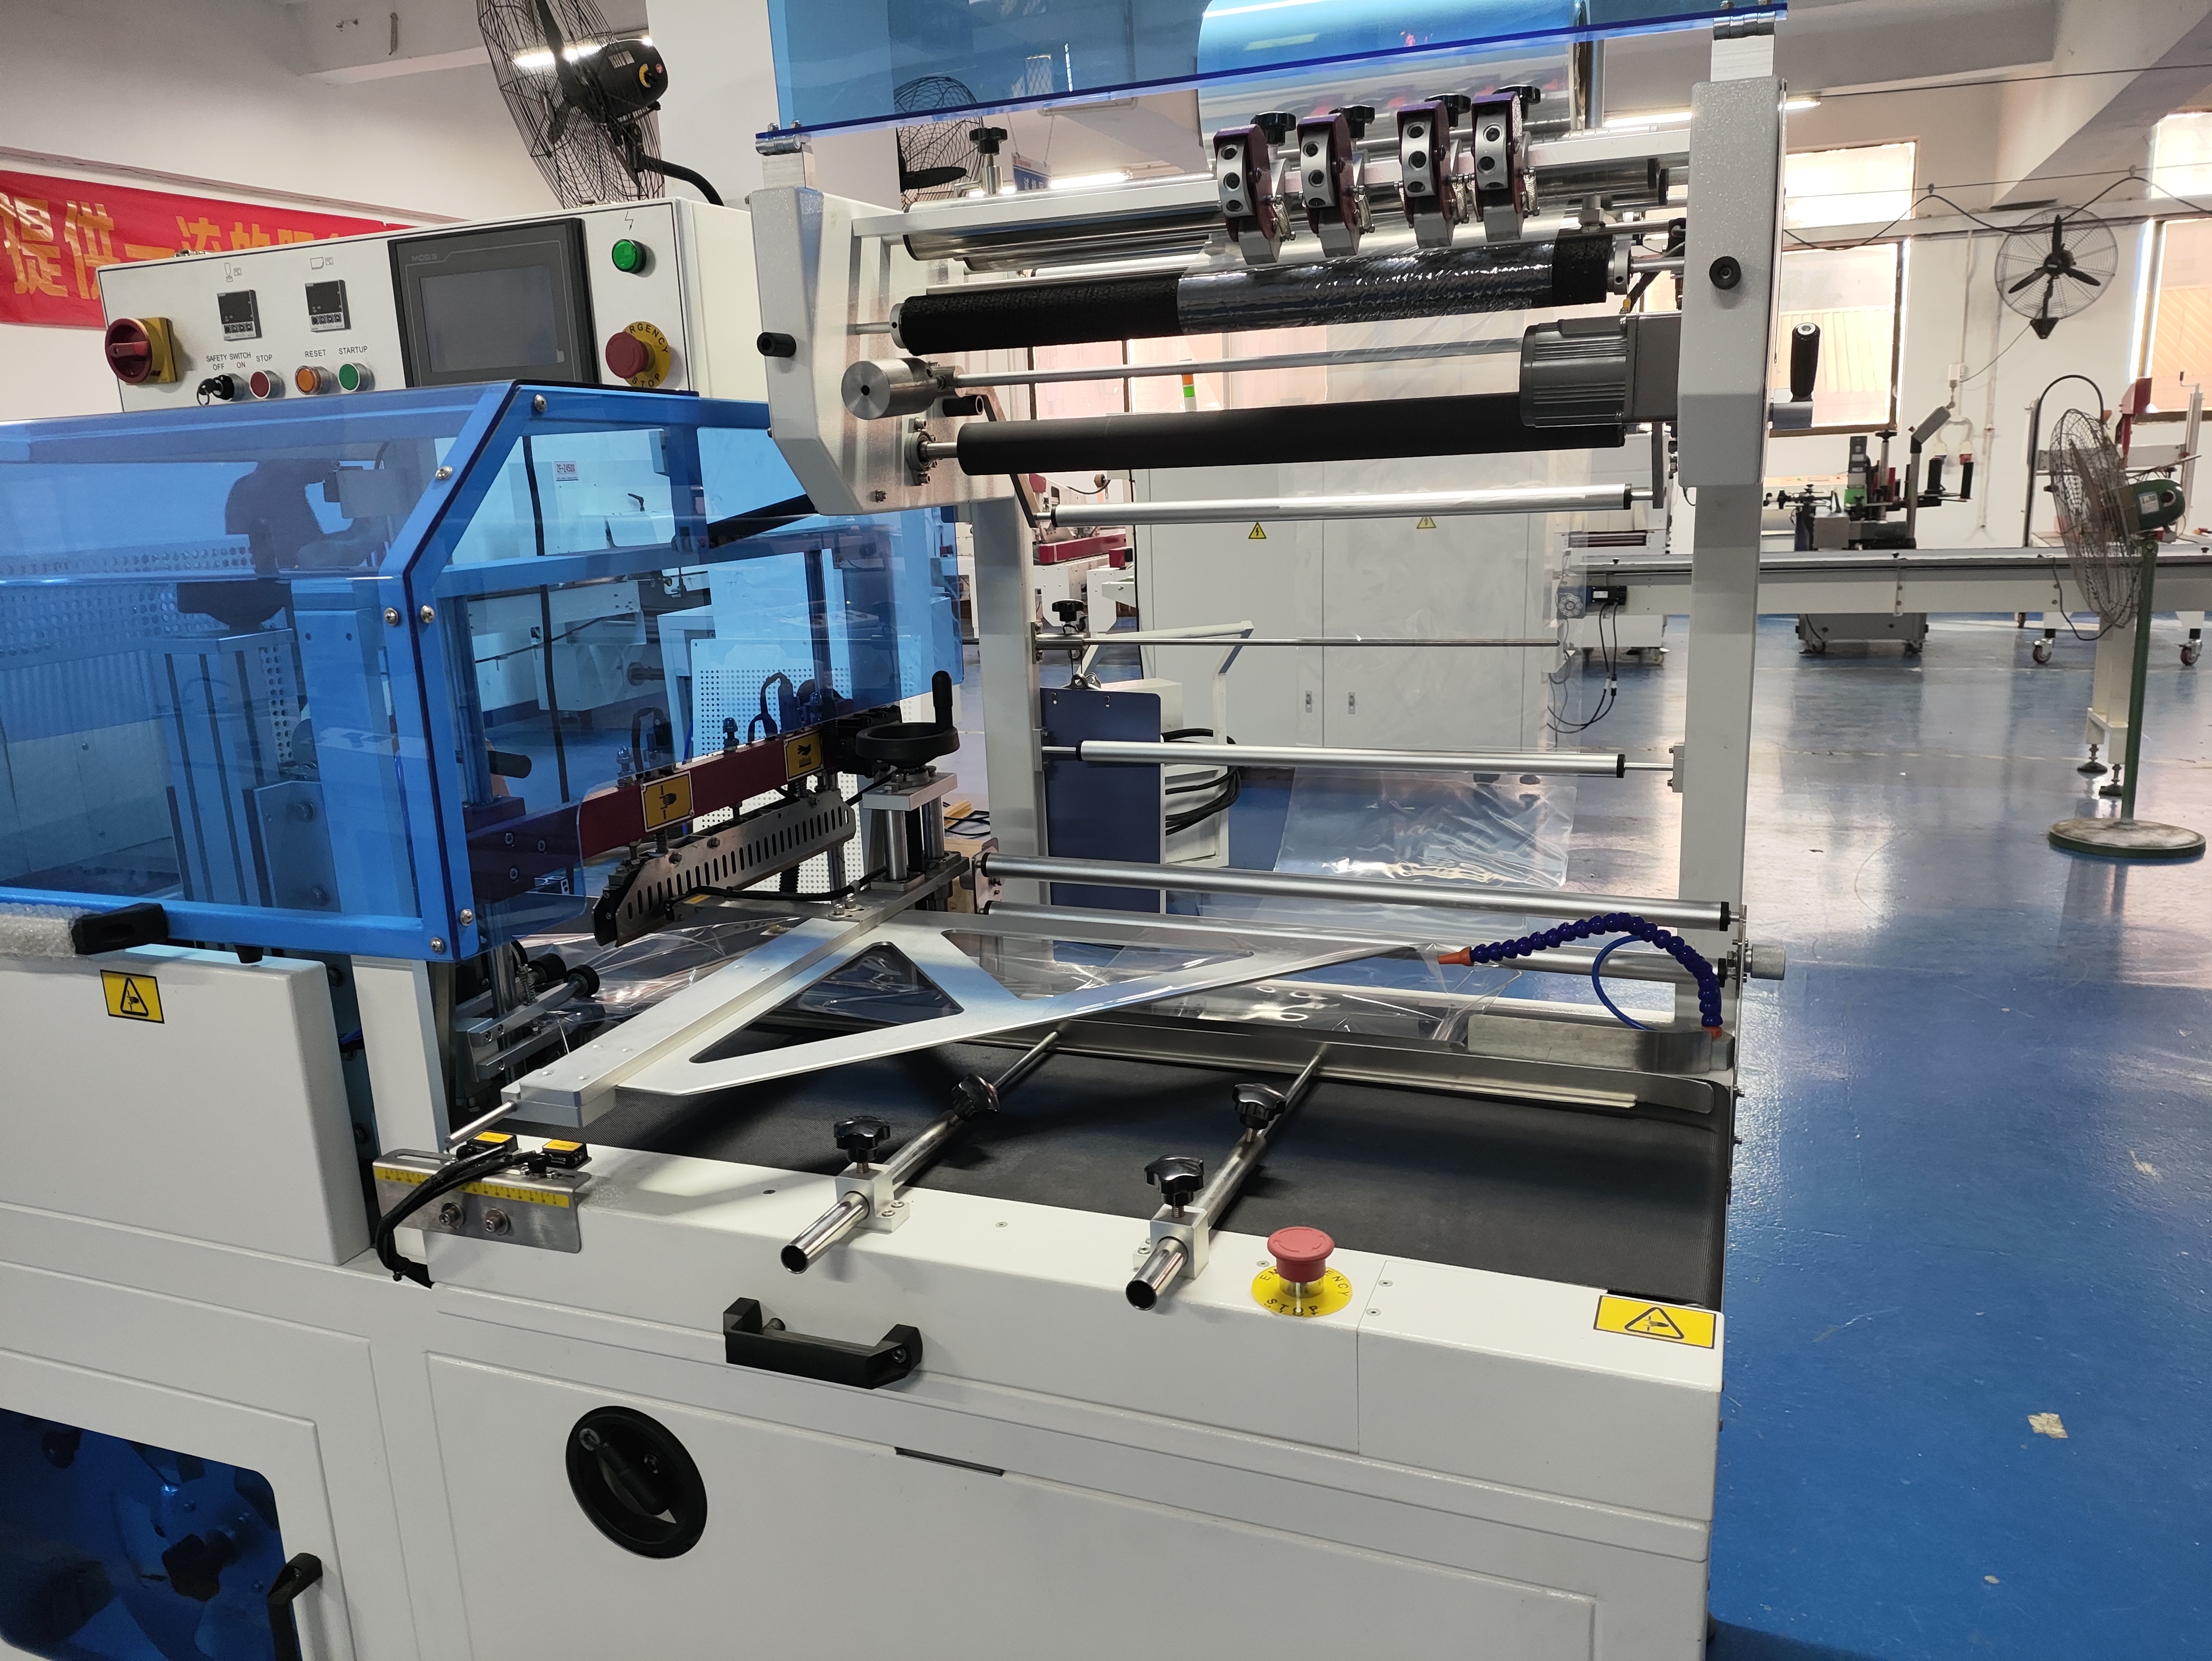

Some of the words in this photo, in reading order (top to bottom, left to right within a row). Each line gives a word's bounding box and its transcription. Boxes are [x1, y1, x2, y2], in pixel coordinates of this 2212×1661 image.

[629, 323, 669, 353] RGENCY
[304, 349, 326, 357] RESET
[339, 345, 368, 355] STARTUP
[206, 354, 227, 362] SAFETY
[229, 352, 251, 360] SWITCH
[256, 354, 273, 362] STOP
[632, 373, 660, 387] STOP
[1266, 1298, 1318, 1316] STOP
